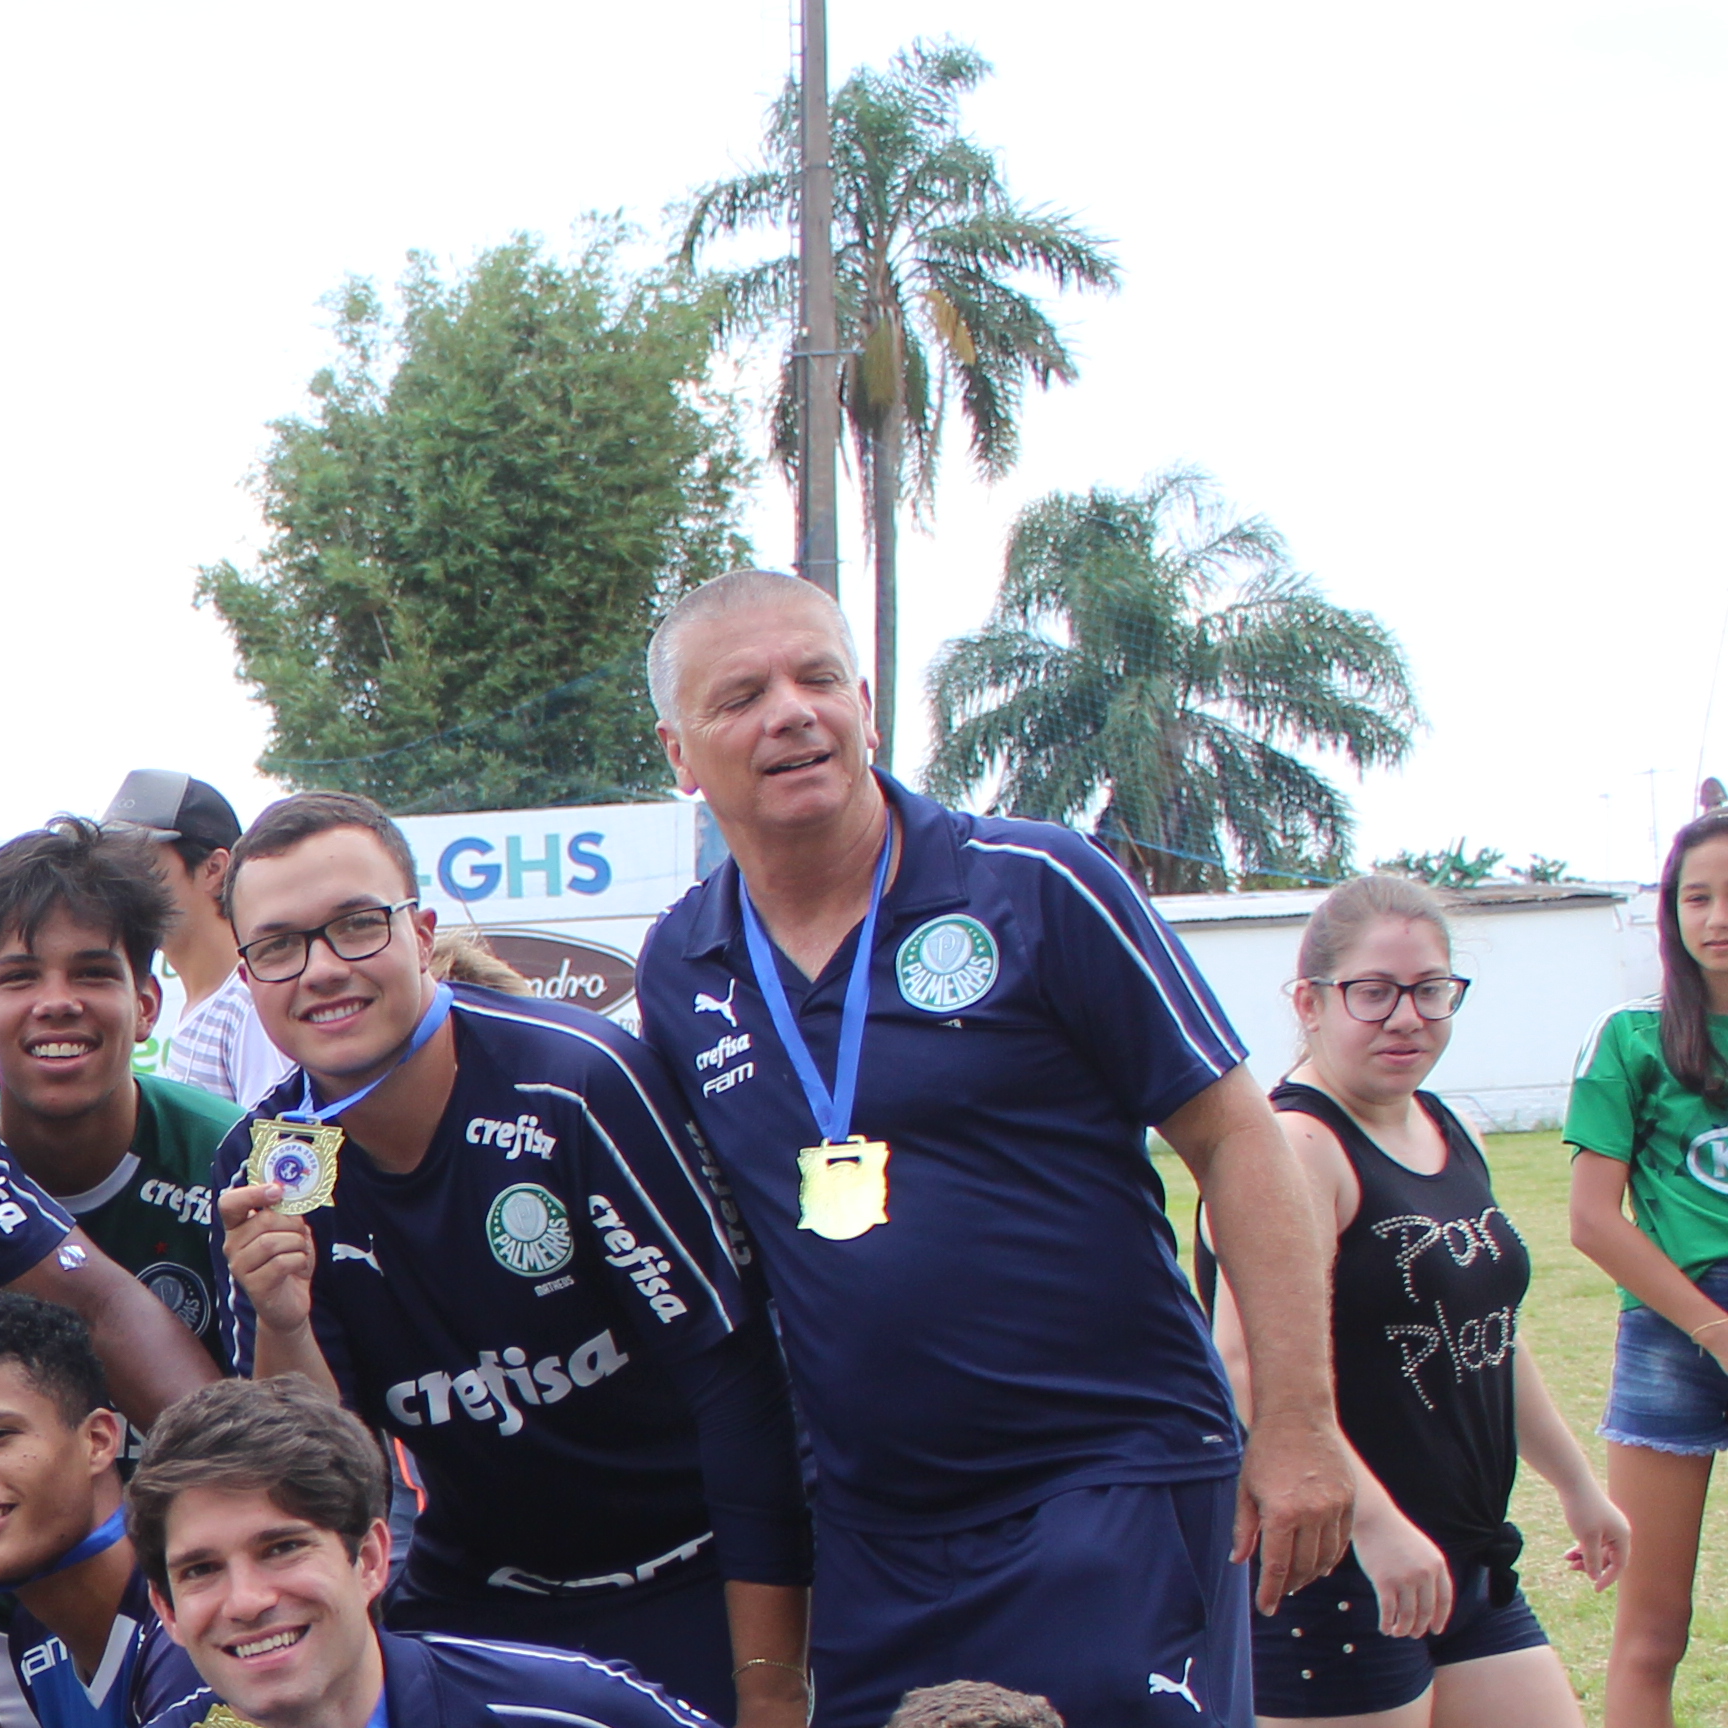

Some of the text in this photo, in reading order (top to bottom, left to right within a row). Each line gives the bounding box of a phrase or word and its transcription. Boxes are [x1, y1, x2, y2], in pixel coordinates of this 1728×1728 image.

[901, 955, 992, 1008] PALMEIRAS
[695, 1032, 752, 1073] crefisa
[492, 1216, 575, 1275] PALMEIRAS
[587, 1194, 690, 1324] crefisa
[385, 1328, 630, 1436] crefisa
